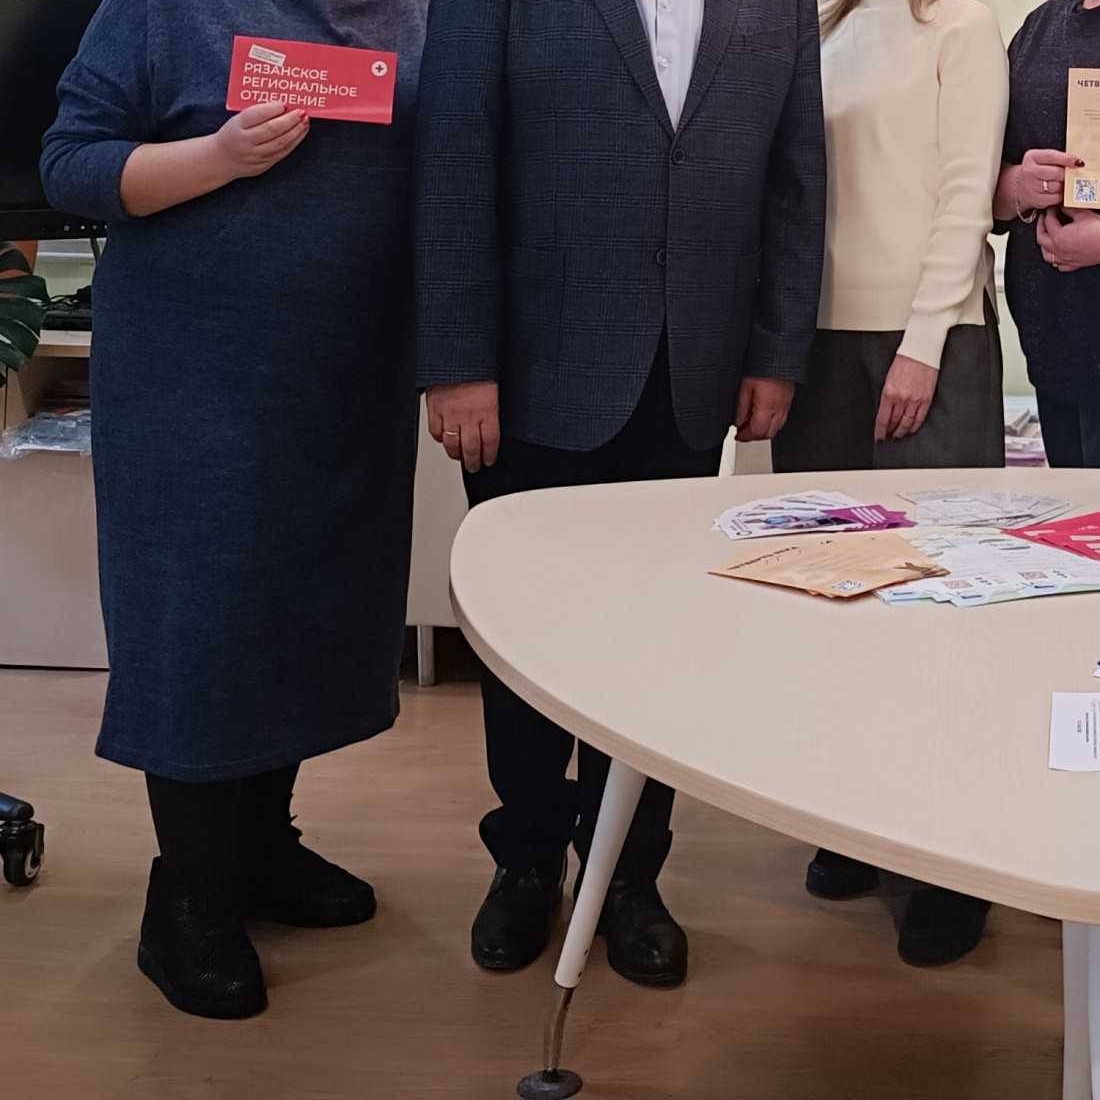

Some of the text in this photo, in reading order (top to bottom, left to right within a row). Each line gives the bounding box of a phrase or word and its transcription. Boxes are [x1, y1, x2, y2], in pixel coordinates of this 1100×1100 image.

[244, 62, 328, 81] РЯЗАНСКОЕ
[242, 76, 358, 97] РЕГИОНАЛЬНОЕ
[240, 90, 327, 108] ОТДЕЛЕНИЕ
